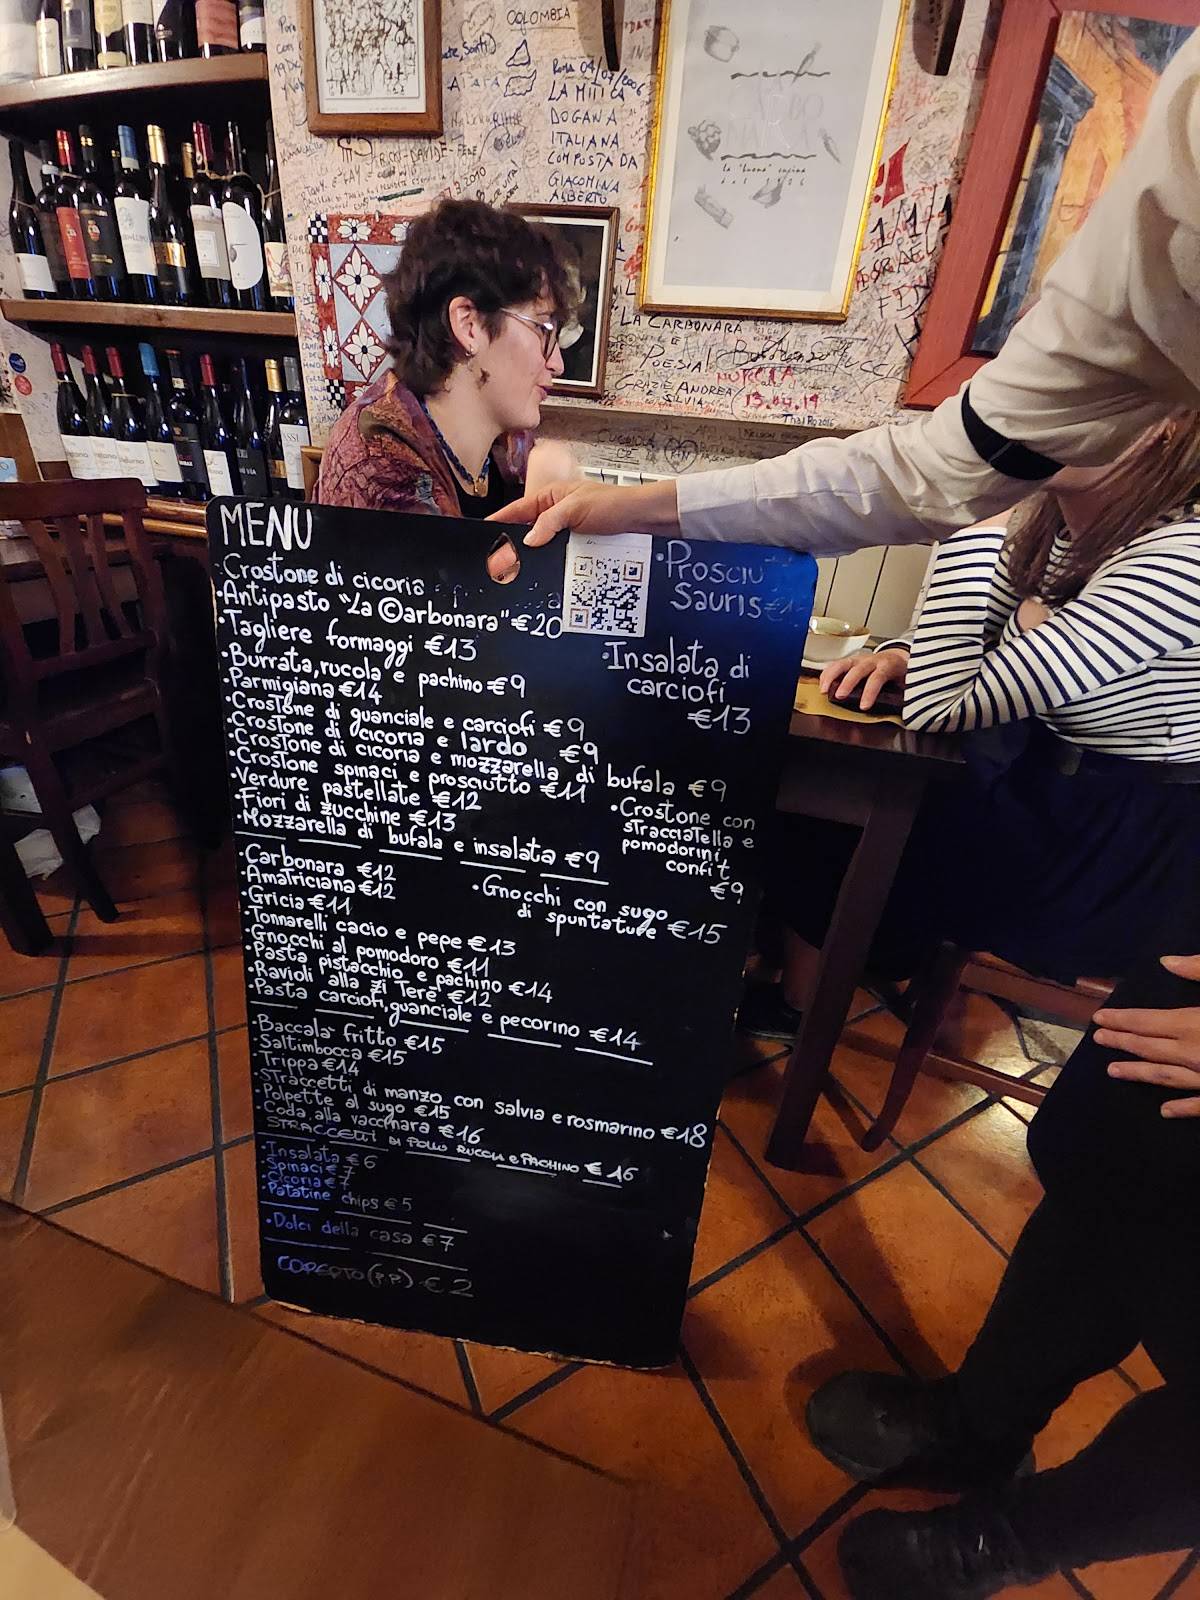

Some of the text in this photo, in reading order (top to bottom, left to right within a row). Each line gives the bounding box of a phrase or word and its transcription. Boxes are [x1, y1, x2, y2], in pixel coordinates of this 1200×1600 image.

[551, 107, 618, 126] DOGANA
[551, 131, 620, 149] ITALIANA
[547, 152, 638, 172] COMPOSTA DA
[676, 380, 734, 397] ANDREA
[219, 502, 313, 551] MENU
[223, 551, 319, 585] Crostone
[326, 561, 344, 586] di
[353, 572, 425, 596] cicoria
[223, 580, 563, 639] Antipasto €20
[223, 609, 478, 669] Tagliere formaggi €13
[604, 637, 751, 679] Insalata di
[229, 667, 383, 705] Parmigiana €14
[393, 670, 405, 683] e
[418, 668, 483, 697] pachino
[627, 677, 727, 704] carciofi
[232, 690, 314, 718] Crostone
[325, 702, 341, 719] di
[350, 706, 434, 737] guanciale
[444, 717, 455, 729] e
[463, 710, 536, 737] carciofi
[687, 706, 751, 735] €13
[232, 711, 314, 736] Crostone
[325, 721, 341, 739] di
[359, 727, 424, 747] cicoria
[437, 736, 448, 748] e
[461, 731, 528, 756] lardo
[235, 728, 322, 754] Crostone
[329, 740, 347, 757] di
[356, 743, 420, 763] cicoria
[431, 752, 441, 764] e
[451, 753, 559, 780] mozzarella
[576, 765, 595, 783] di
[607, 763, 675, 796] bufala
[237, 747, 318, 773] Crostone
[334, 763, 398, 785] spinaci
[410, 771, 420, 782] e
[540, 782, 585, 803] €11
[237, 767, 482, 810] Verdure pastellate €12
[239, 787, 457, 831] Fiori di zucchine €13
[620, 797, 755, 831] Crostone con
[243, 808, 346, 836] Mozzarella
[358, 823, 373, 840] di
[388, 825, 442, 849] bufala
[454, 840, 464, 852] e
[473, 835, 556, 865] insalata
[622, 838, 721, 862] pomodorini
[742, 837, 754, 848] e
[245, 843, 397, 881] Carbonara €12
[247, 864, 396, 900] Amatriciana €12
[248, 885, 351, 915] Gricia €11
[482, 874, 668, 934] Gnocchi con sugo
[248, 905, 516, 956] Tonnarelli cacio e pepe €13
[517, 903, 531, 918] di
[667, 920, 728, 944] €15
[251, 924, 489, 978] Gnocchi al pomodoro €11
[253, 941, 552, 1004] Pasta pistacchio e pachino €14
[254, 960, 313, 983] Ravioli
[328, 972, 359, 989] alla
[447, 989, 492, 1008] €12
[254, 978, 642, 1051] Pasta e pecorino €14
[259, 1033, 407, 1066] Saltimbocca €15
[343, 1023, 396, 1047] fritto
[404, 1035, 445, 1054] €15
[258, 1050, 360, 1076] Trippa €14
[264, 1084, 450, 1122] Polpette al sugo €15
[363, 1081, 376, 1097] di
[385, 1087, 442, 1104] manzo
[453, 1095, 484, 1109] con
[494, 1099, 545, 1121] salvia
[552, 1113, 562, 1124] e
[567, 1114, 655, 1140] rosmarino
[660, 1123, 707, 1148] €18
[264, 1100, 485, 1145] Coda alla vaccinara €16
[265, 1140, 340, 1163] Insalata
[266, 1157, 323, 1176] Spinaci
[267, 1171, 321, 1188] Cicoria
[268, 1182, 379, 1213] Patatine chips
[273, 1212, 312, 1231] Dolci
[321, 1219, 359, 1237] della
[370, 1229, 413, 1245] casa
